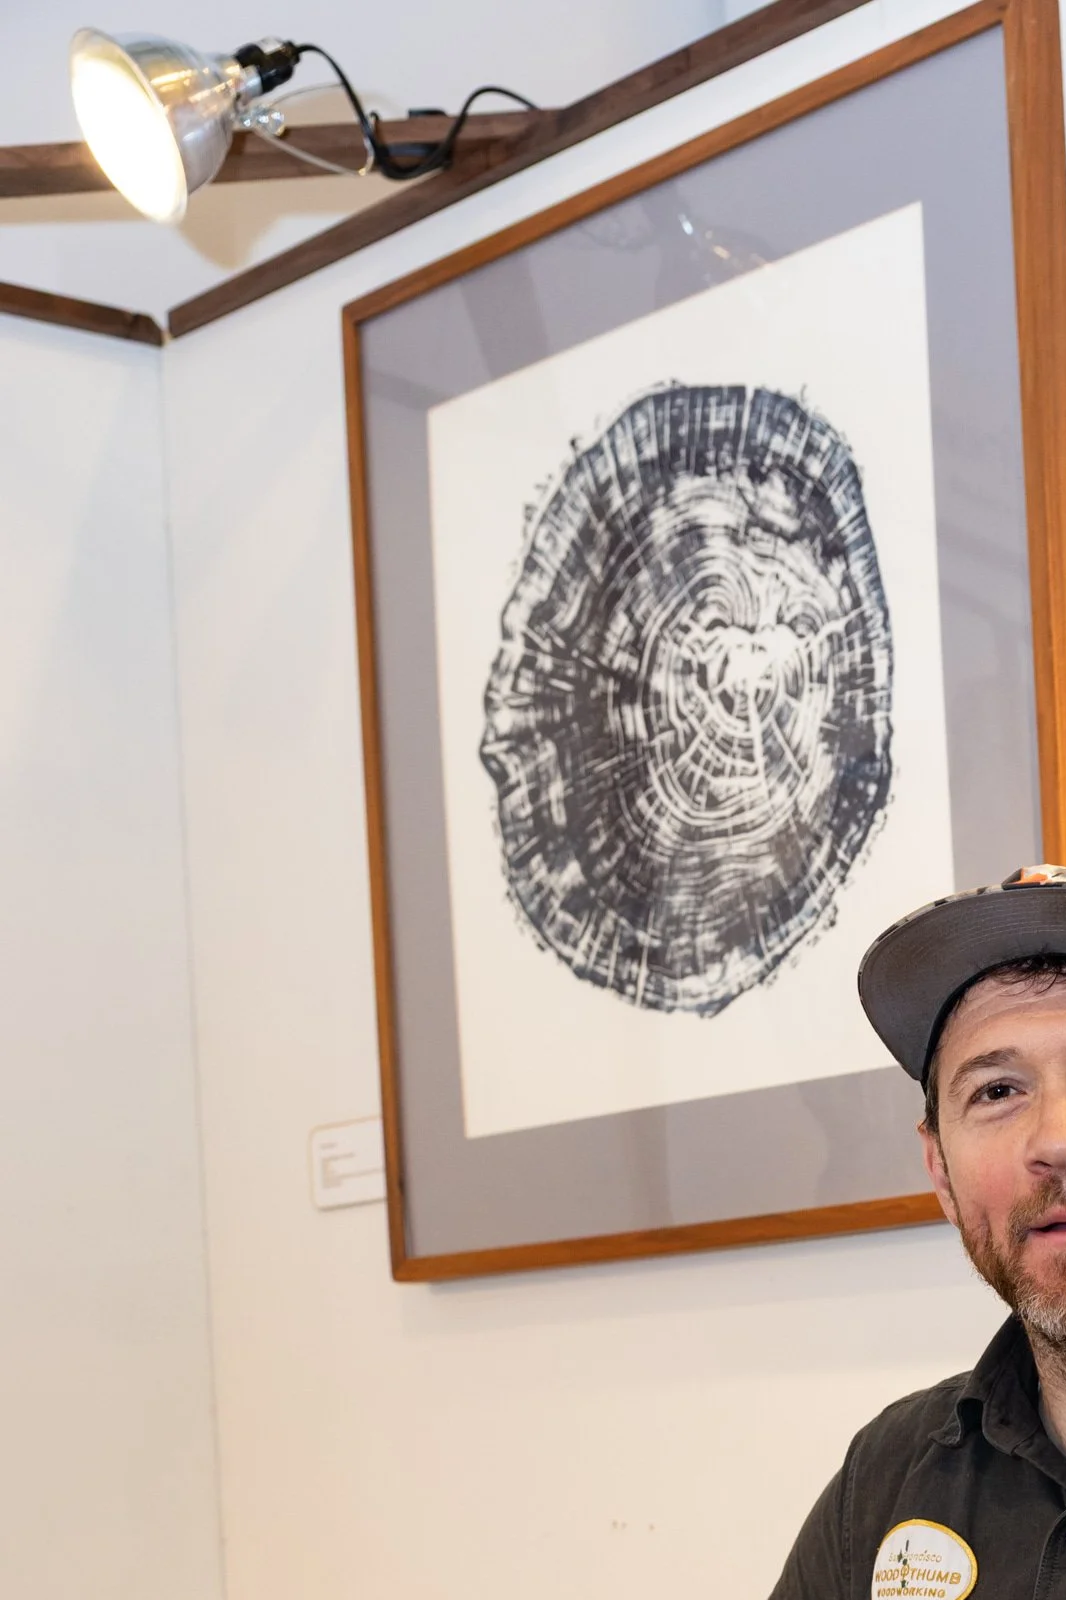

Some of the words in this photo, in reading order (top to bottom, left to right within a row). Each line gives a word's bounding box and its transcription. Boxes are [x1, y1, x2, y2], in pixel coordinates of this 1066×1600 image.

[875, 1569, 900, 1583] WOOD
[910, 1568, 962, 1585] THUMB
[877, 1587, 946, 1598] WOODWORKING
